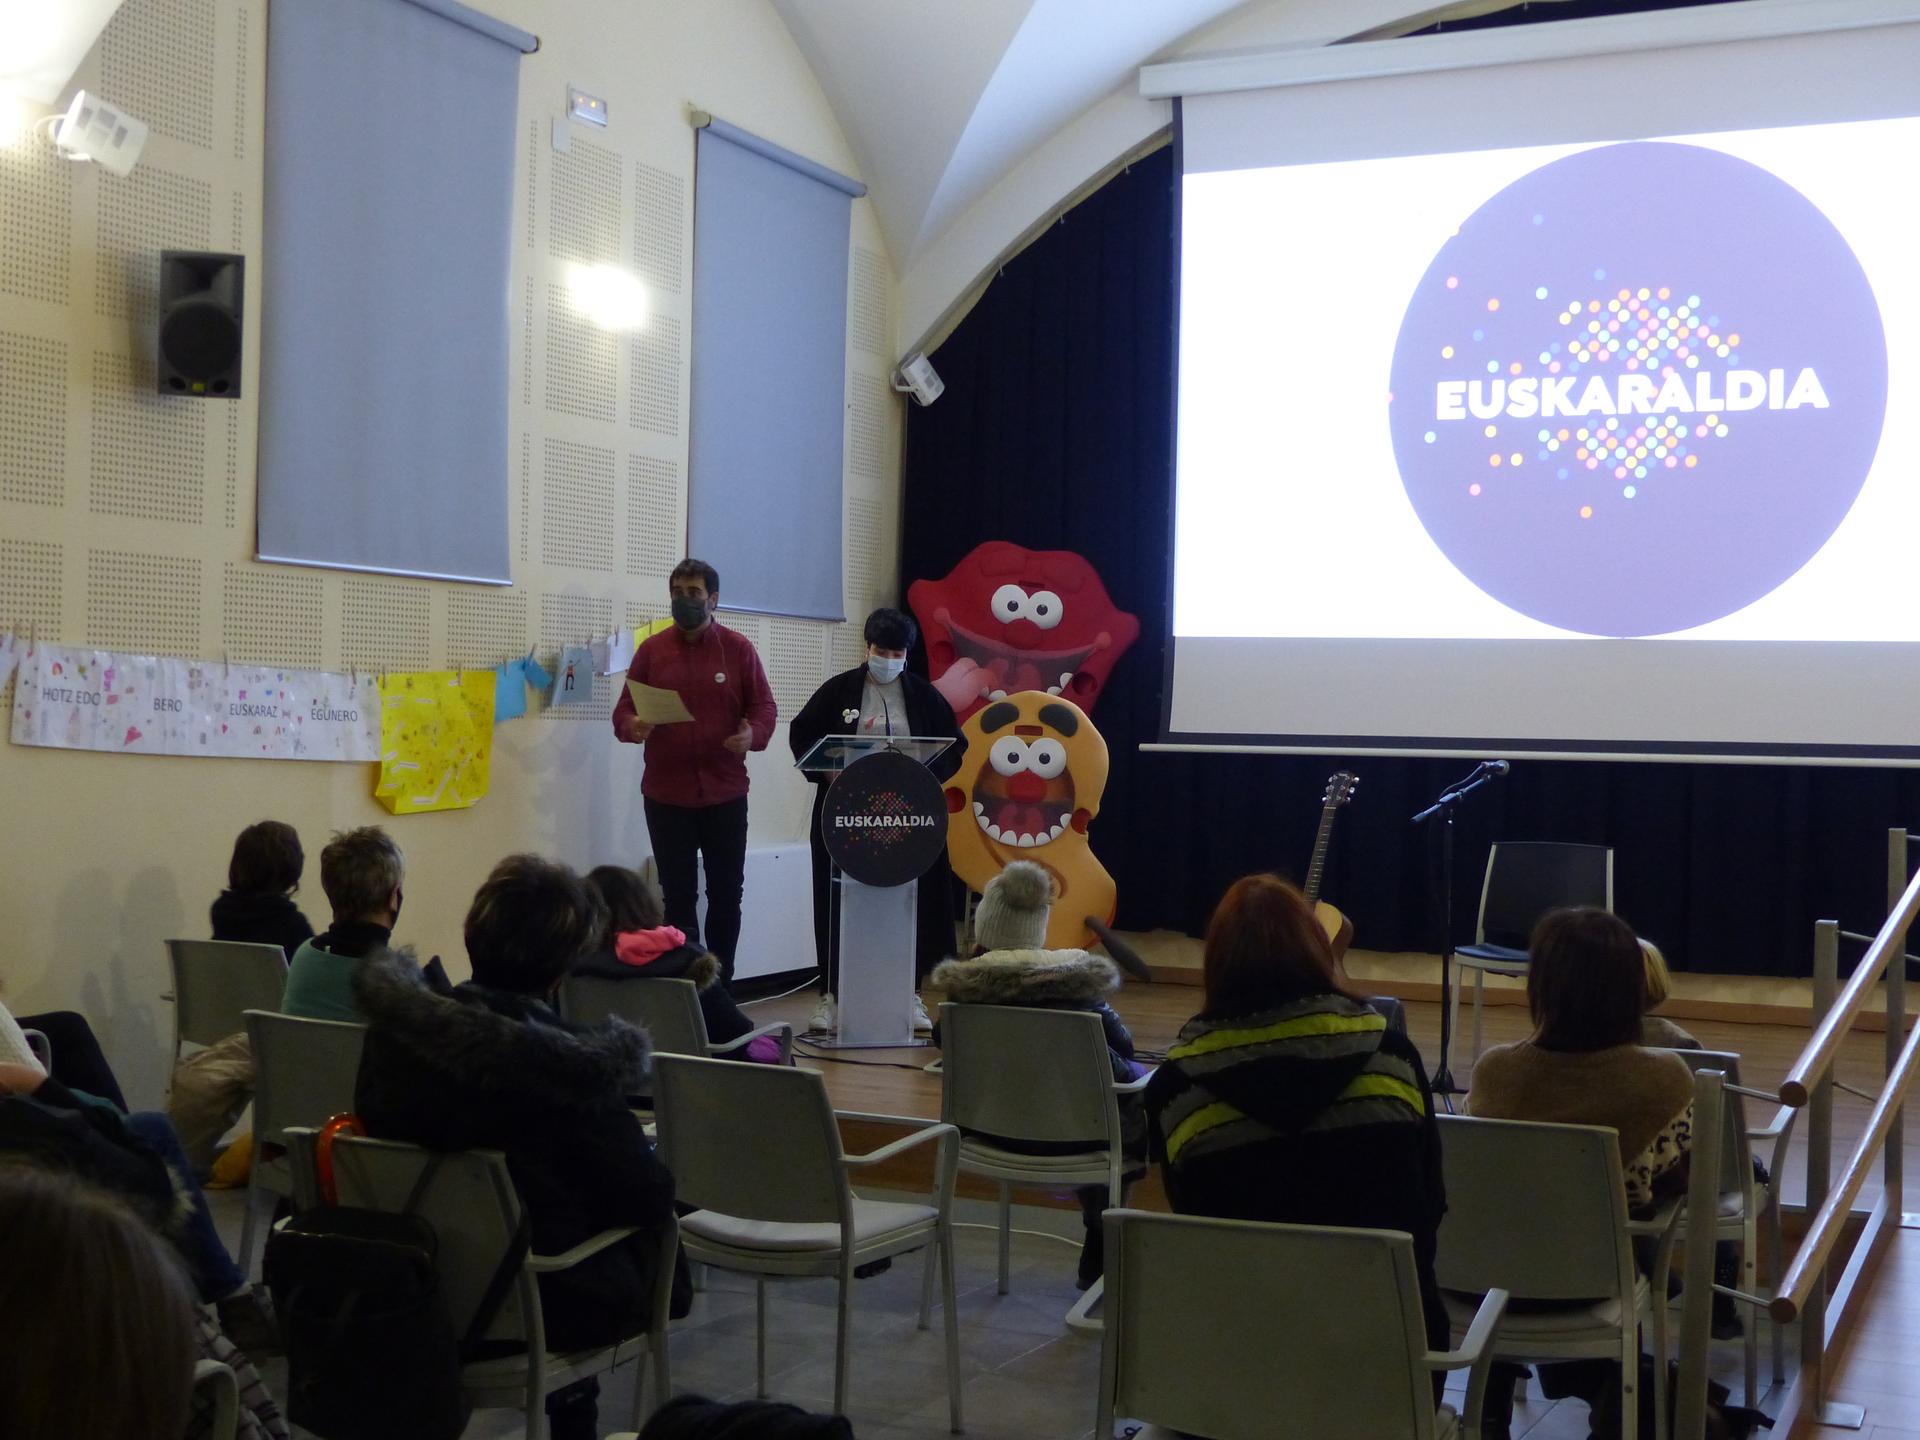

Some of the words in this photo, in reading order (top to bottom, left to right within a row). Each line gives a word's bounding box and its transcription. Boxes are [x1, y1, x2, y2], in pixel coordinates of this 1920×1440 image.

[1436, 367, 1830, 420] EUSKARALDIA
[42, 687, 73, 703] HOTZ
[76, 690, 101, 706] EDO
[153, 697, 183, 713] BERO
[229, 703, 278, 719] EUSKARAZ
[311, 708, 358, 722] EGUNERO
[835, 815, 935, 828] EUSKARALDIA
